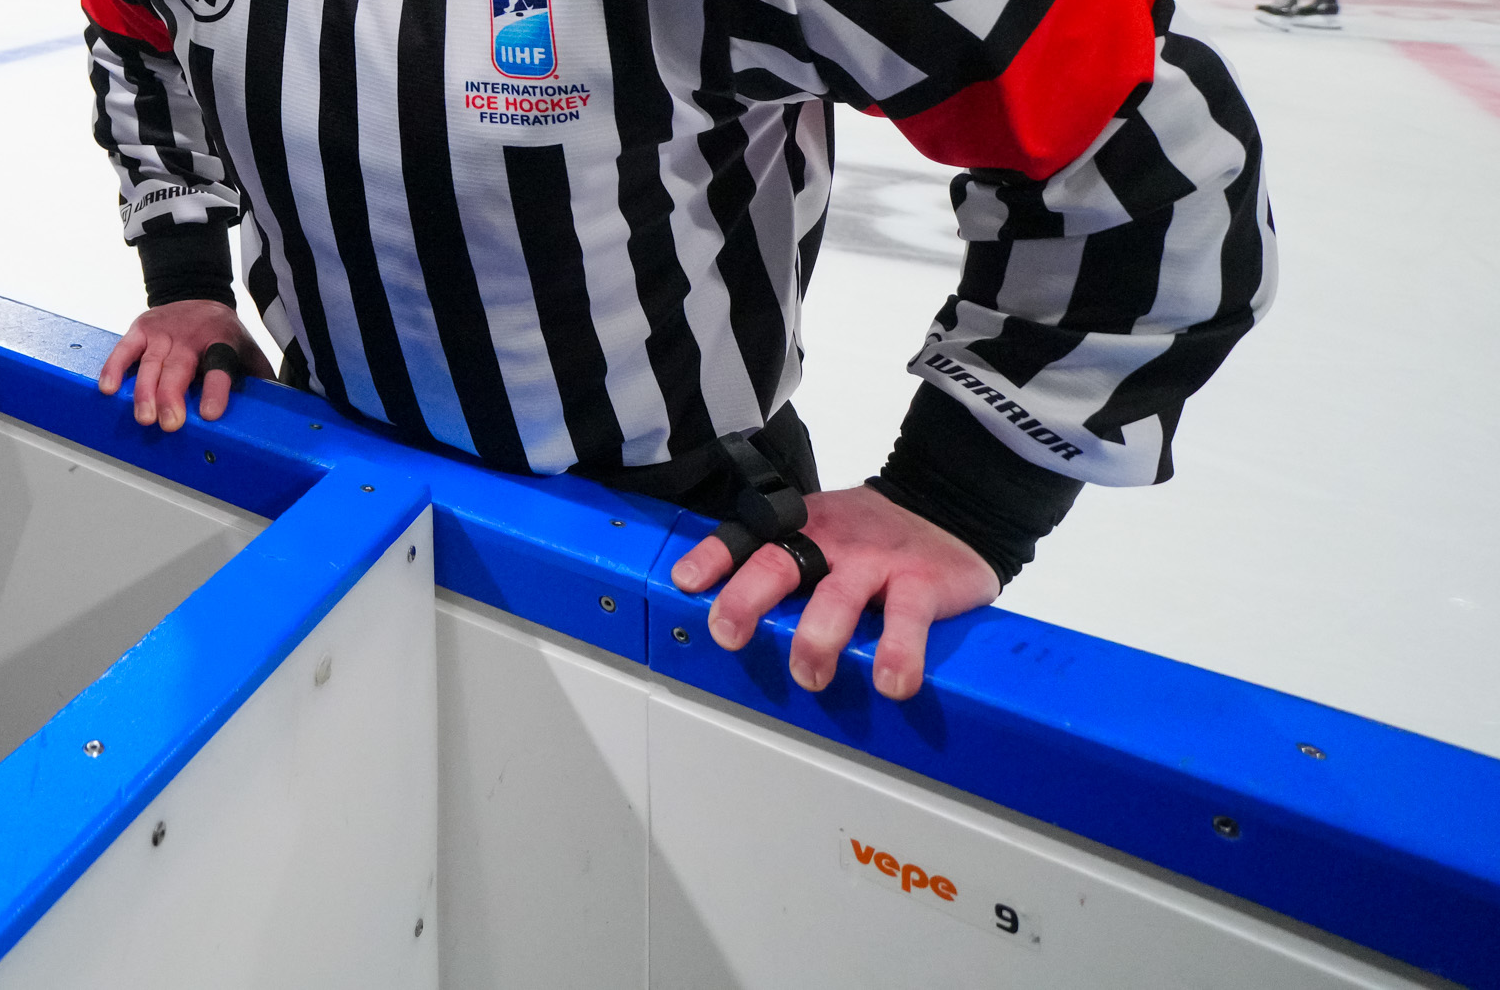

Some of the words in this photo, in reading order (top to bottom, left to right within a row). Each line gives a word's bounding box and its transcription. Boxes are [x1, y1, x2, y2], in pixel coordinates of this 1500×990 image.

[500, 45, 546, 65] IIHF
[465, 81, 591, 97] INTERNATIONAL
[465, 94, 499, 111] ICE
[505, 94, 591, 113] HOCKEY
[479, 110, 580, 126] FEDERATION
[924, 353, 1084, 461] WARRIOR
[850, 837, 958, 902] vepe
[994, 902, 1020, 935] 9
